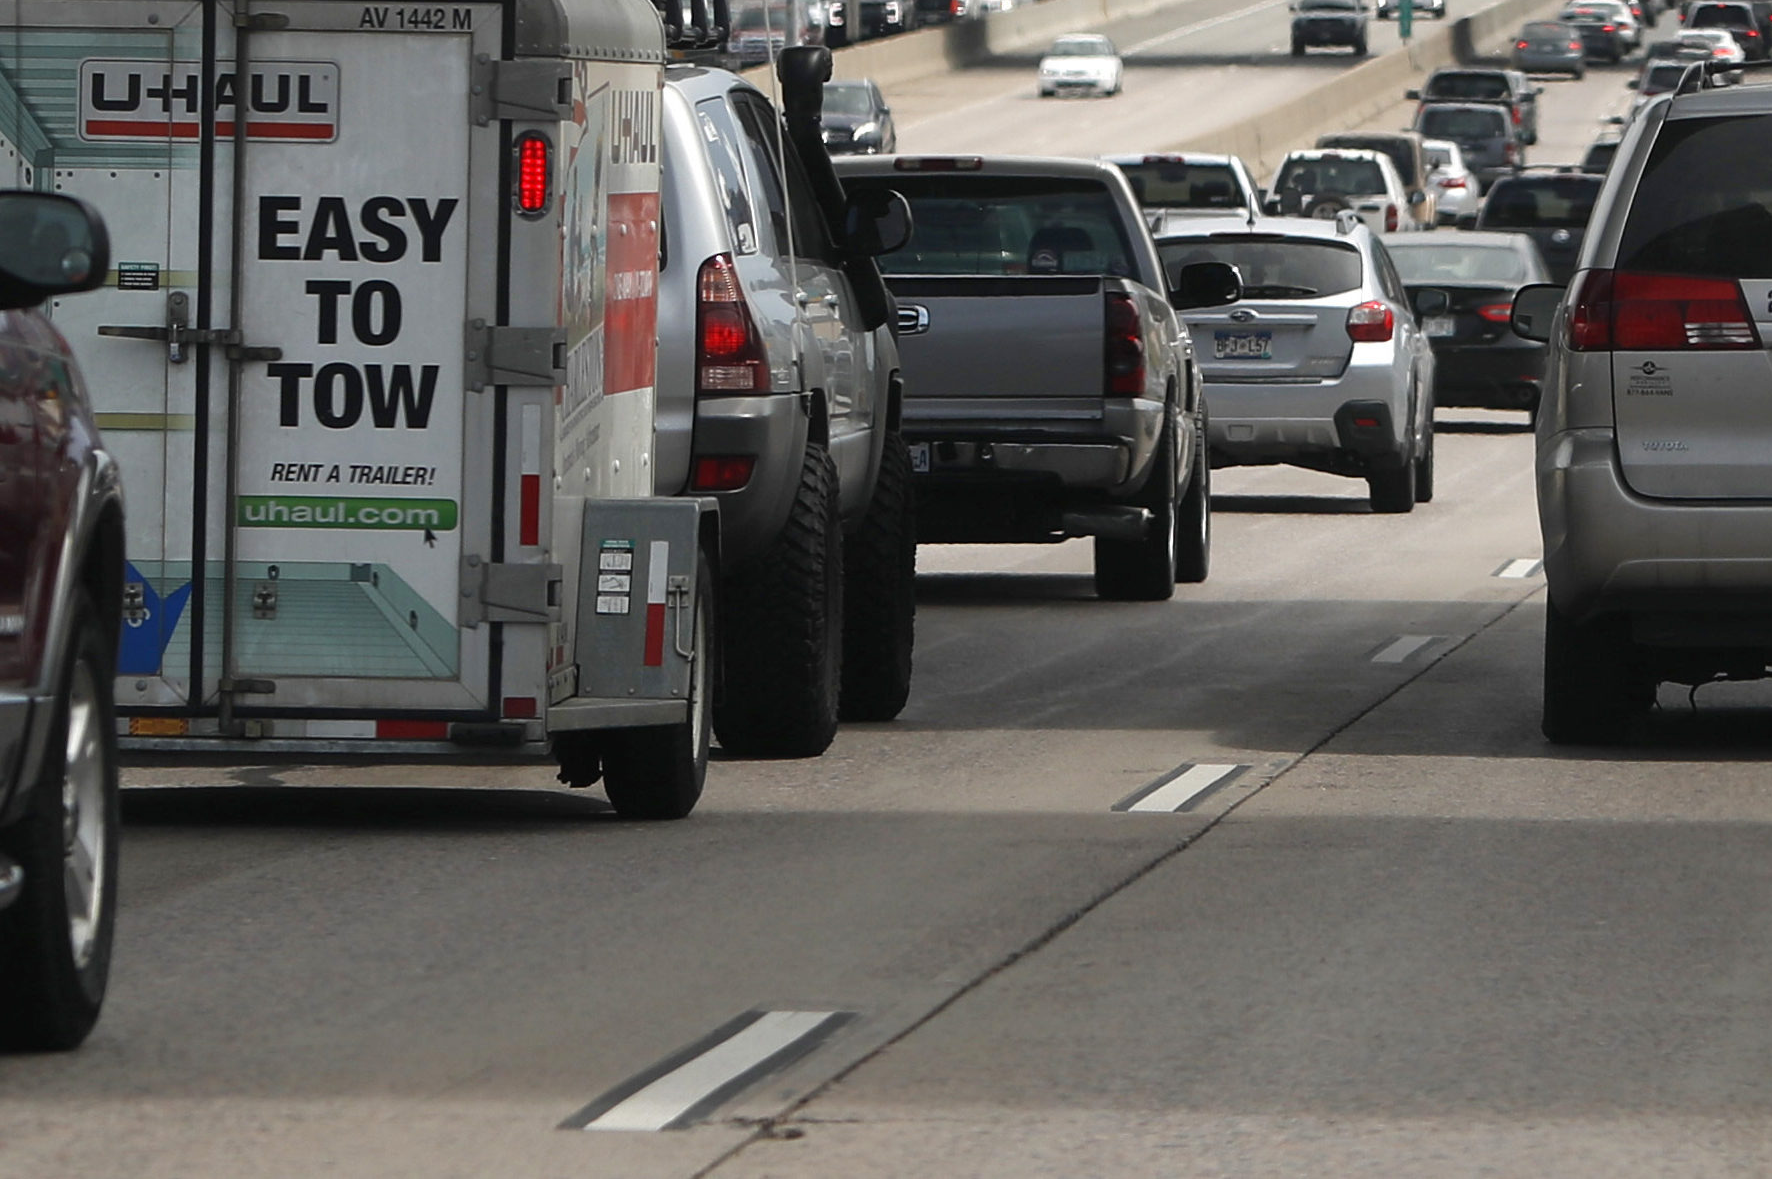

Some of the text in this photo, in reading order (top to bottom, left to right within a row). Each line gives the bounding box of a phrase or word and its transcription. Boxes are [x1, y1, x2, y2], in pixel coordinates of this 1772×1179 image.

[359, 7, 472, 30] AV 1442 M
[258, 196, 459, 263] EASY
[305, 279, 402, 346] TO
[267, 362, 440, 429] TOW
[1642, 440, 1689, 452] TOYOTA
[270, 463, 437, 486] RENT A TRAILER!
[244, 500, 440, 526] uhaul.com
